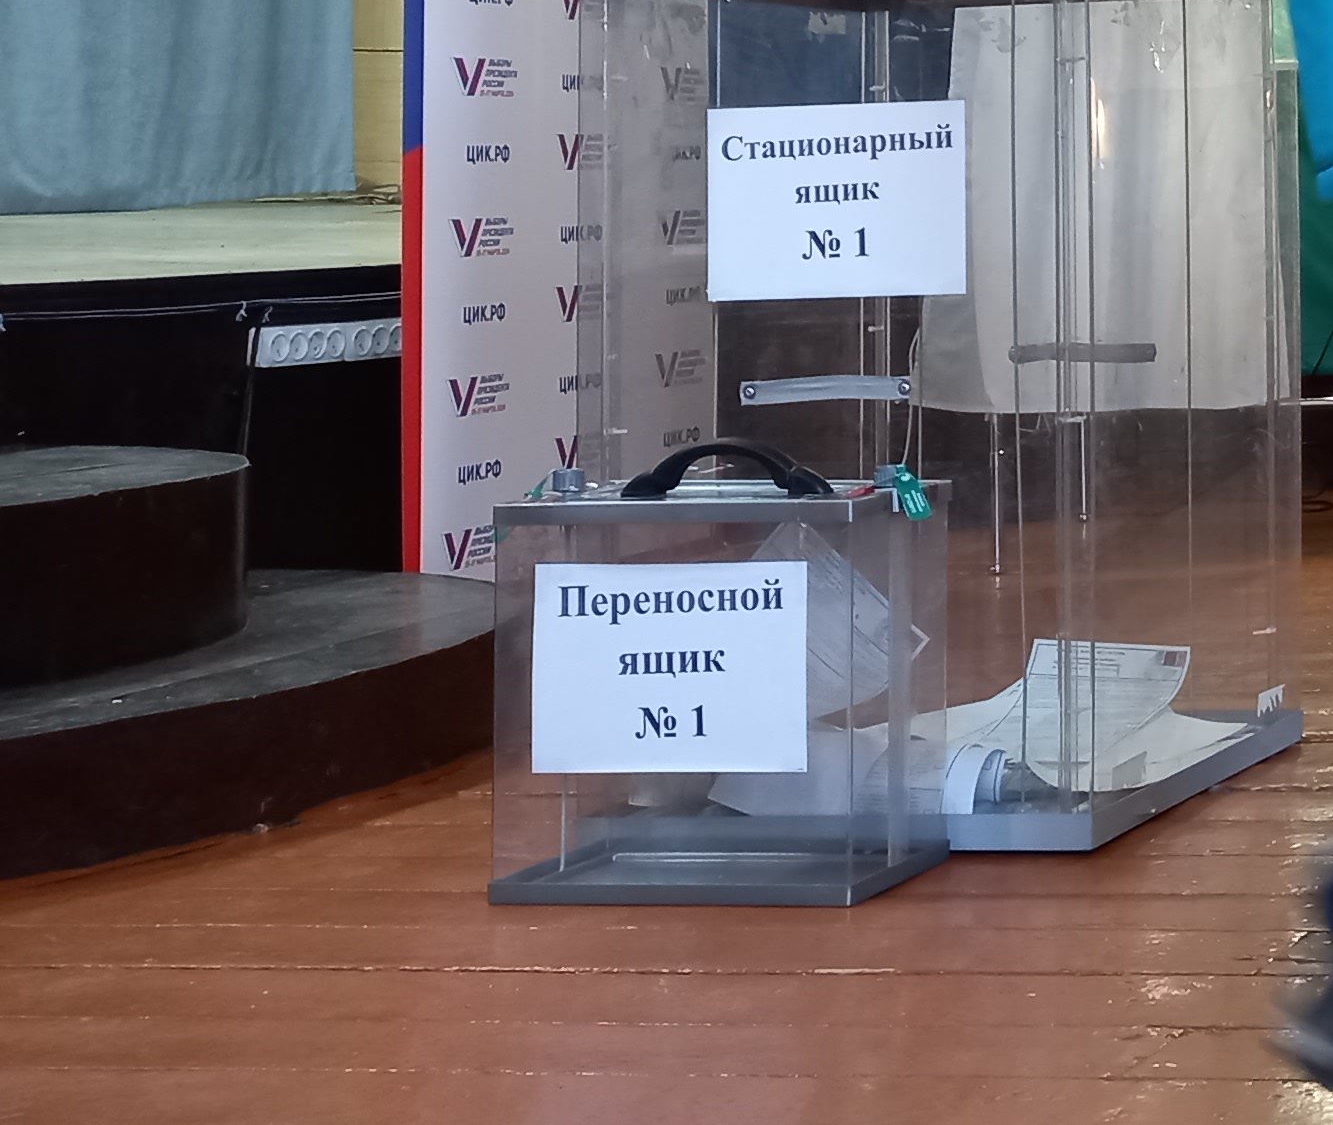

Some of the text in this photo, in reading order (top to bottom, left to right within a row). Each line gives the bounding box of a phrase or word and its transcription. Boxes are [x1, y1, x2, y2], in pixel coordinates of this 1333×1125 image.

[466, 144, 511, 165] ЦИК.РФ
[721, 123, 953, 162] Стационарный
[795, 181, 880, 205] ящик
[802, 227, 870, 261] № 1
[463, 302, 507, 326] ЦИК.РФ
[457, 459, 502, 485] ЦИК.РФ
[557, 578, 784, 625] Переносной
[617, 649, 726, 678] ящик
[634, 704, 708, 740] № 1
